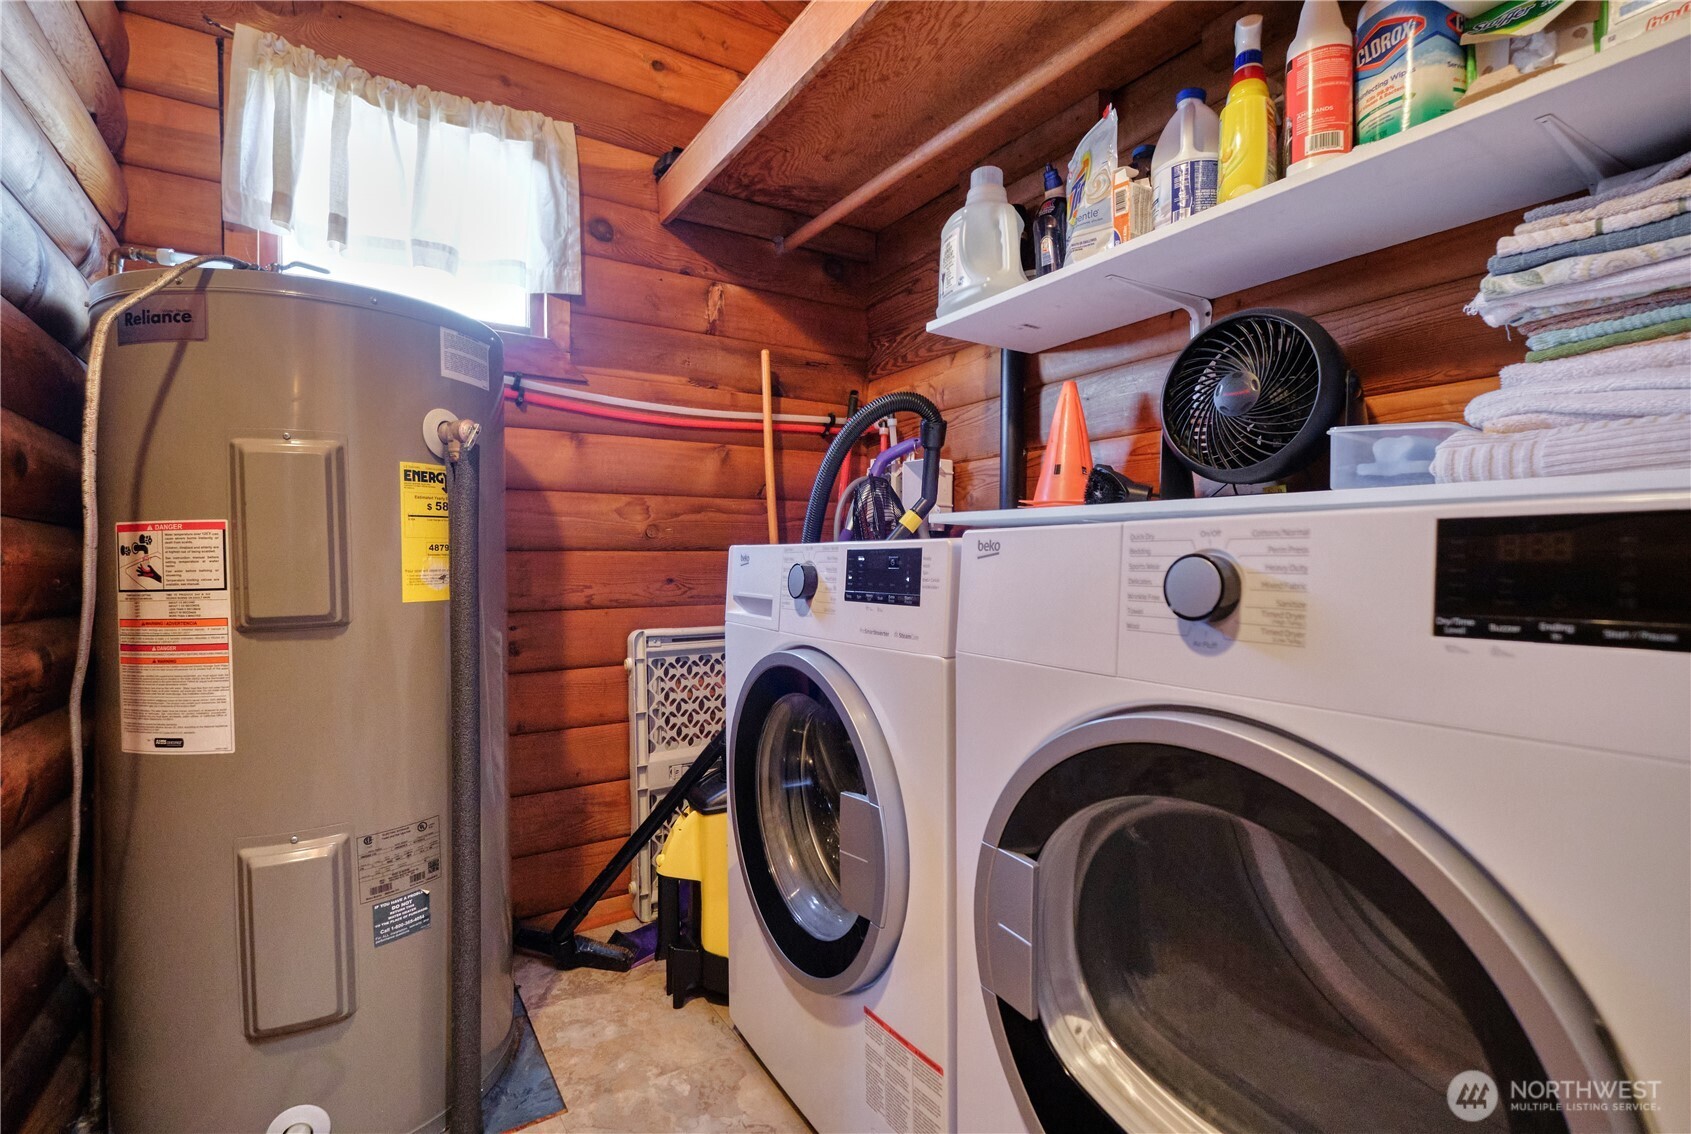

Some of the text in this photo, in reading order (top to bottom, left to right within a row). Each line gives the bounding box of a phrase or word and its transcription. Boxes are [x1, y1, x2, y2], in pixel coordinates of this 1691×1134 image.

[1357, 18, 1416, 67] CLOROX
[1390, 67, 1416, 81] Wips
[125, 309, 192, 327] Reliance
[978, 540, 1000, 552] beko
